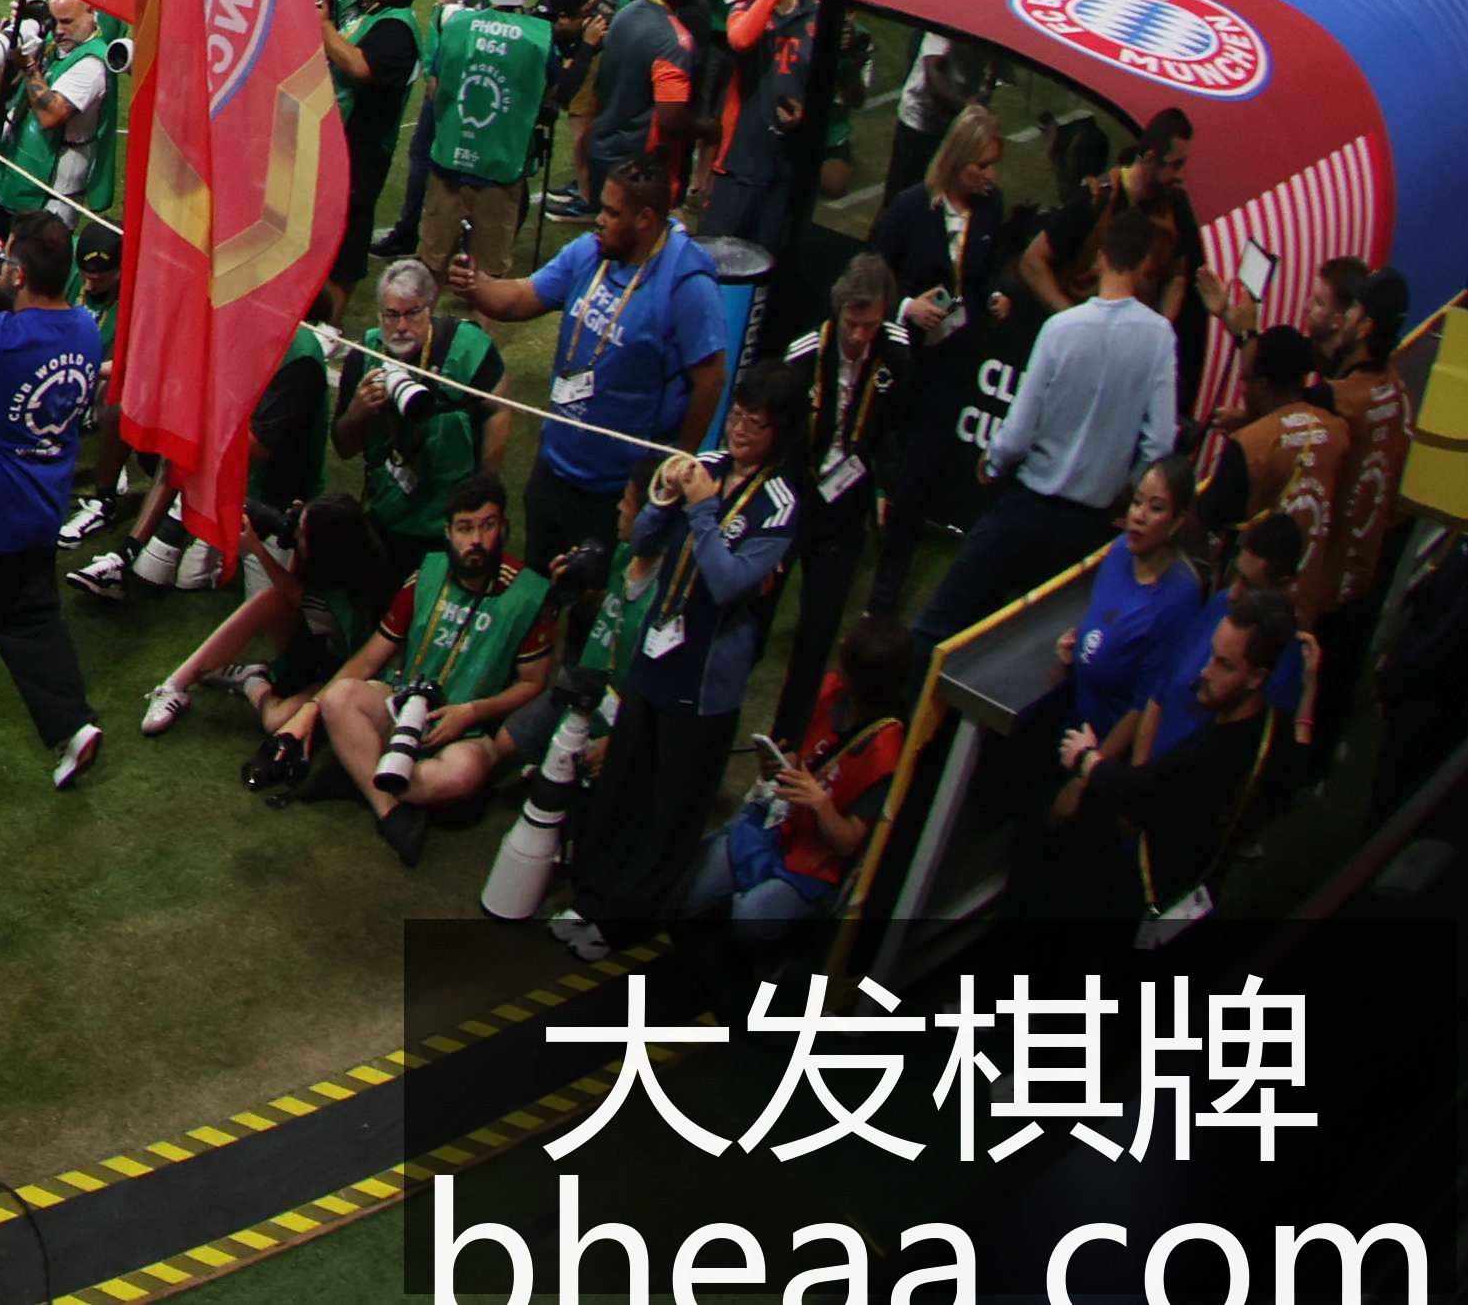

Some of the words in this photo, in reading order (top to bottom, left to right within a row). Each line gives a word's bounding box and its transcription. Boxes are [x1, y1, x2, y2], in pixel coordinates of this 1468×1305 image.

[470, 18, 524, 41] PHOTO
[1030, 0, 1080, 38] FC
[35, 353, 85, 379] WORLD
[976, 357, 1015, 404] CL
[8, 382, 32, 422] CLUB
[956, 405, 1003, 450] CU
